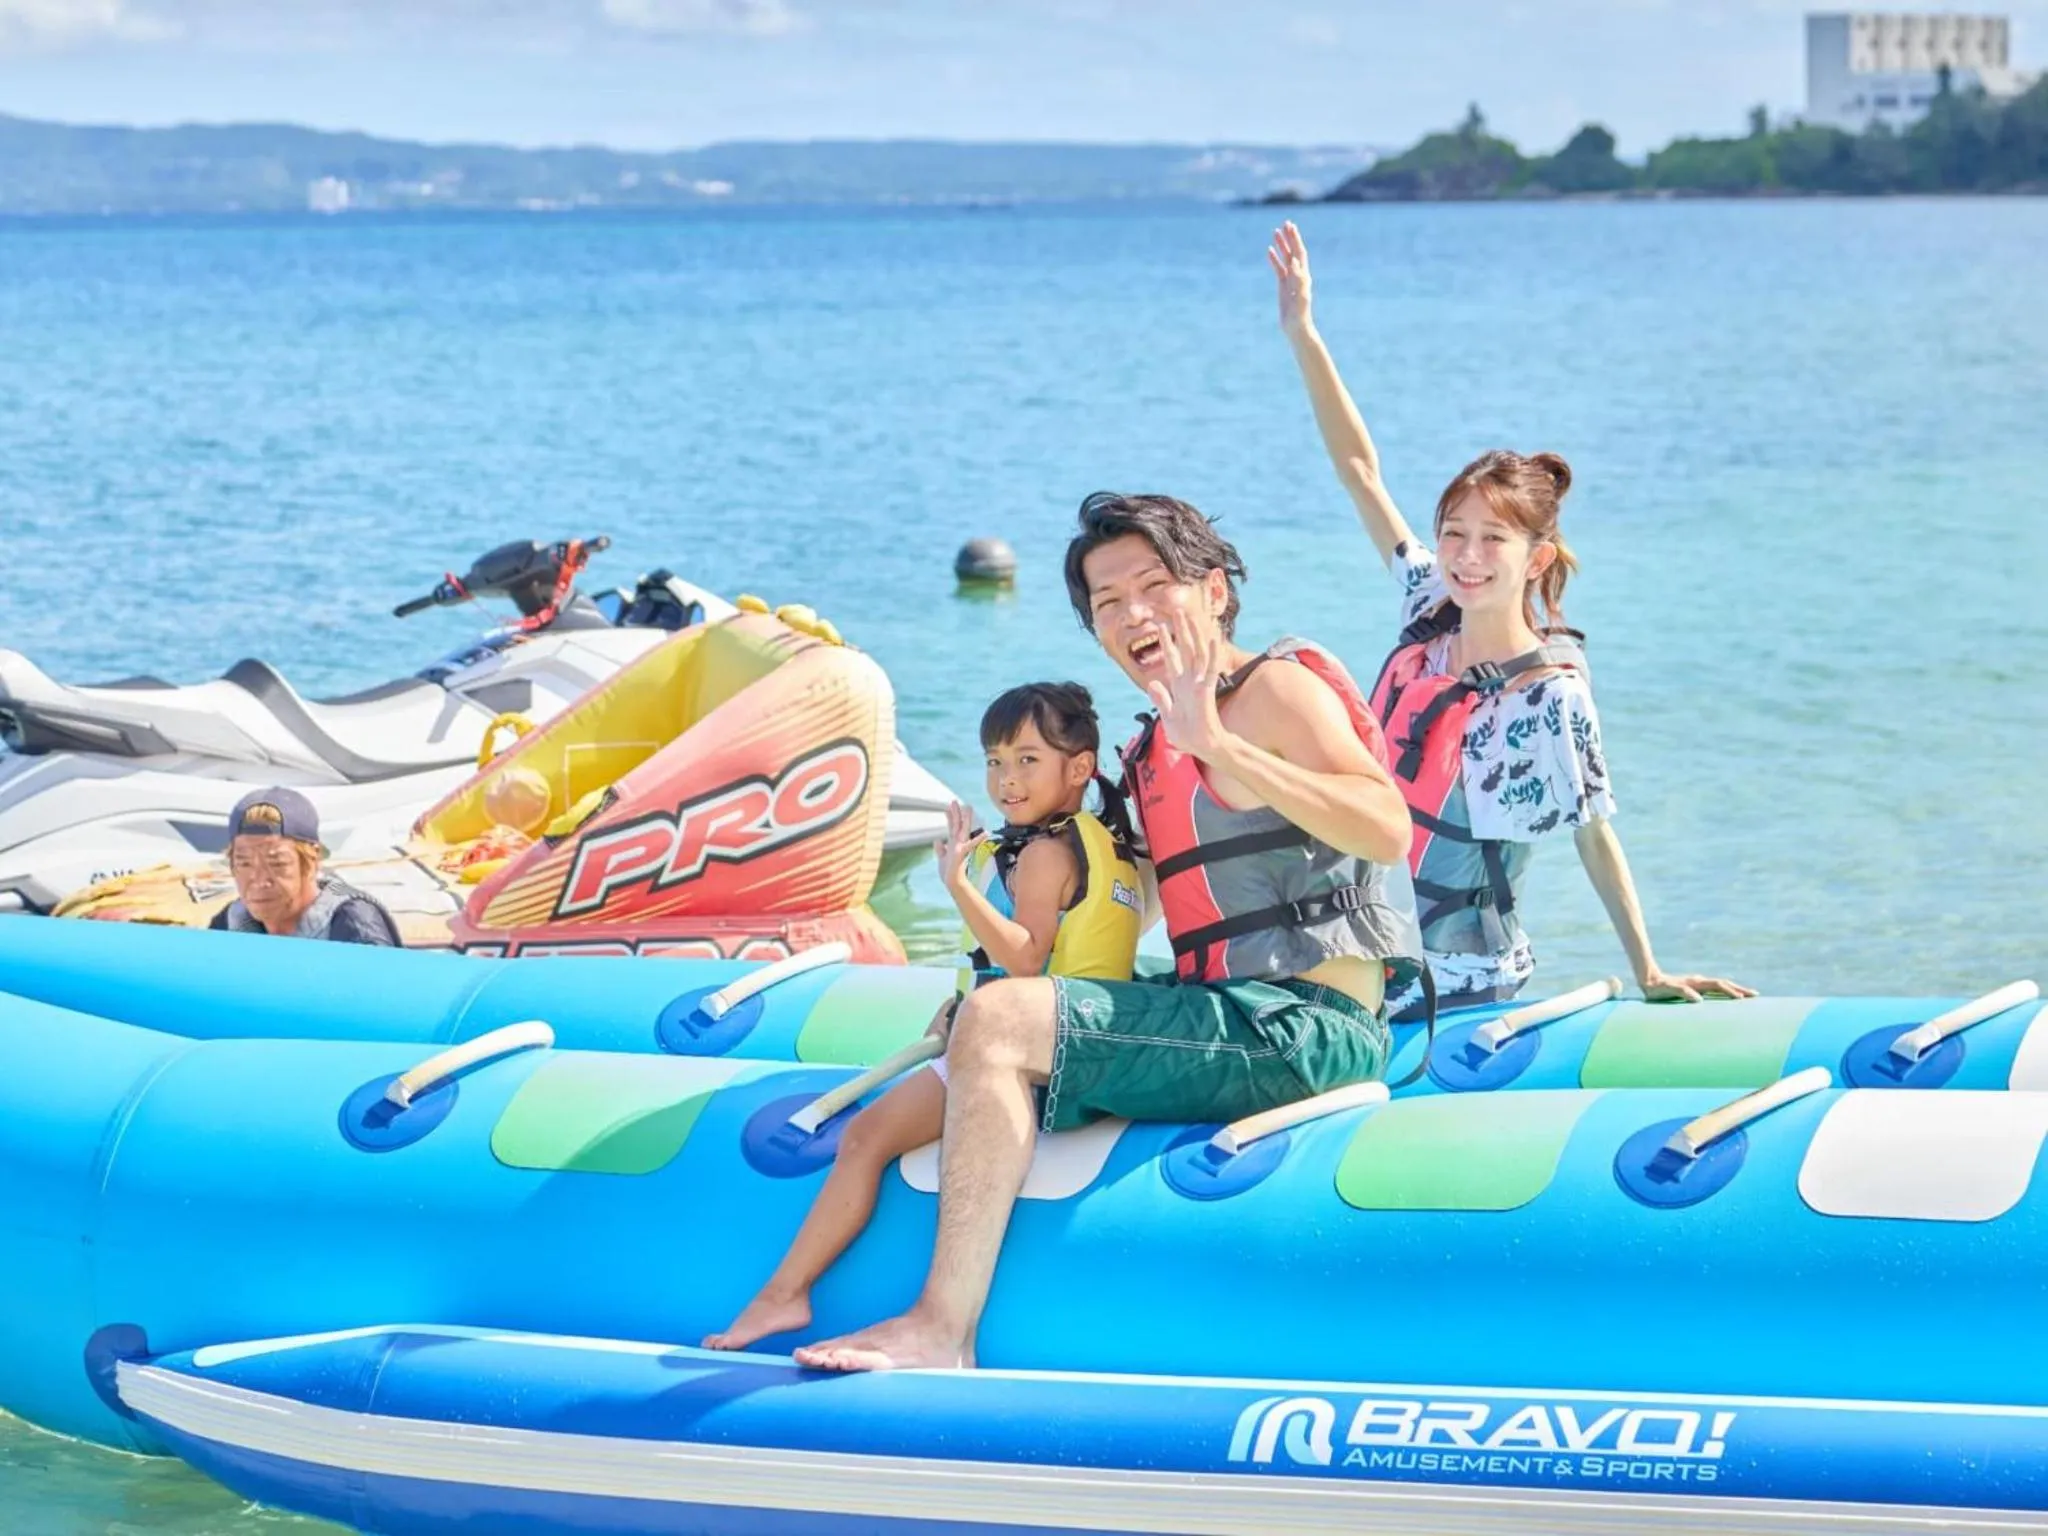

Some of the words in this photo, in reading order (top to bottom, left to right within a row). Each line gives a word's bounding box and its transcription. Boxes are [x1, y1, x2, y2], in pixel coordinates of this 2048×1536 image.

[552, 738, 869, 920] PRO
[1346, 1398, 1737, 1458] BRAVO!
[1341, 1447, 1553, 1475] AMUSEMENT
[1581, 1456, 1717, 1482] SPORTS
